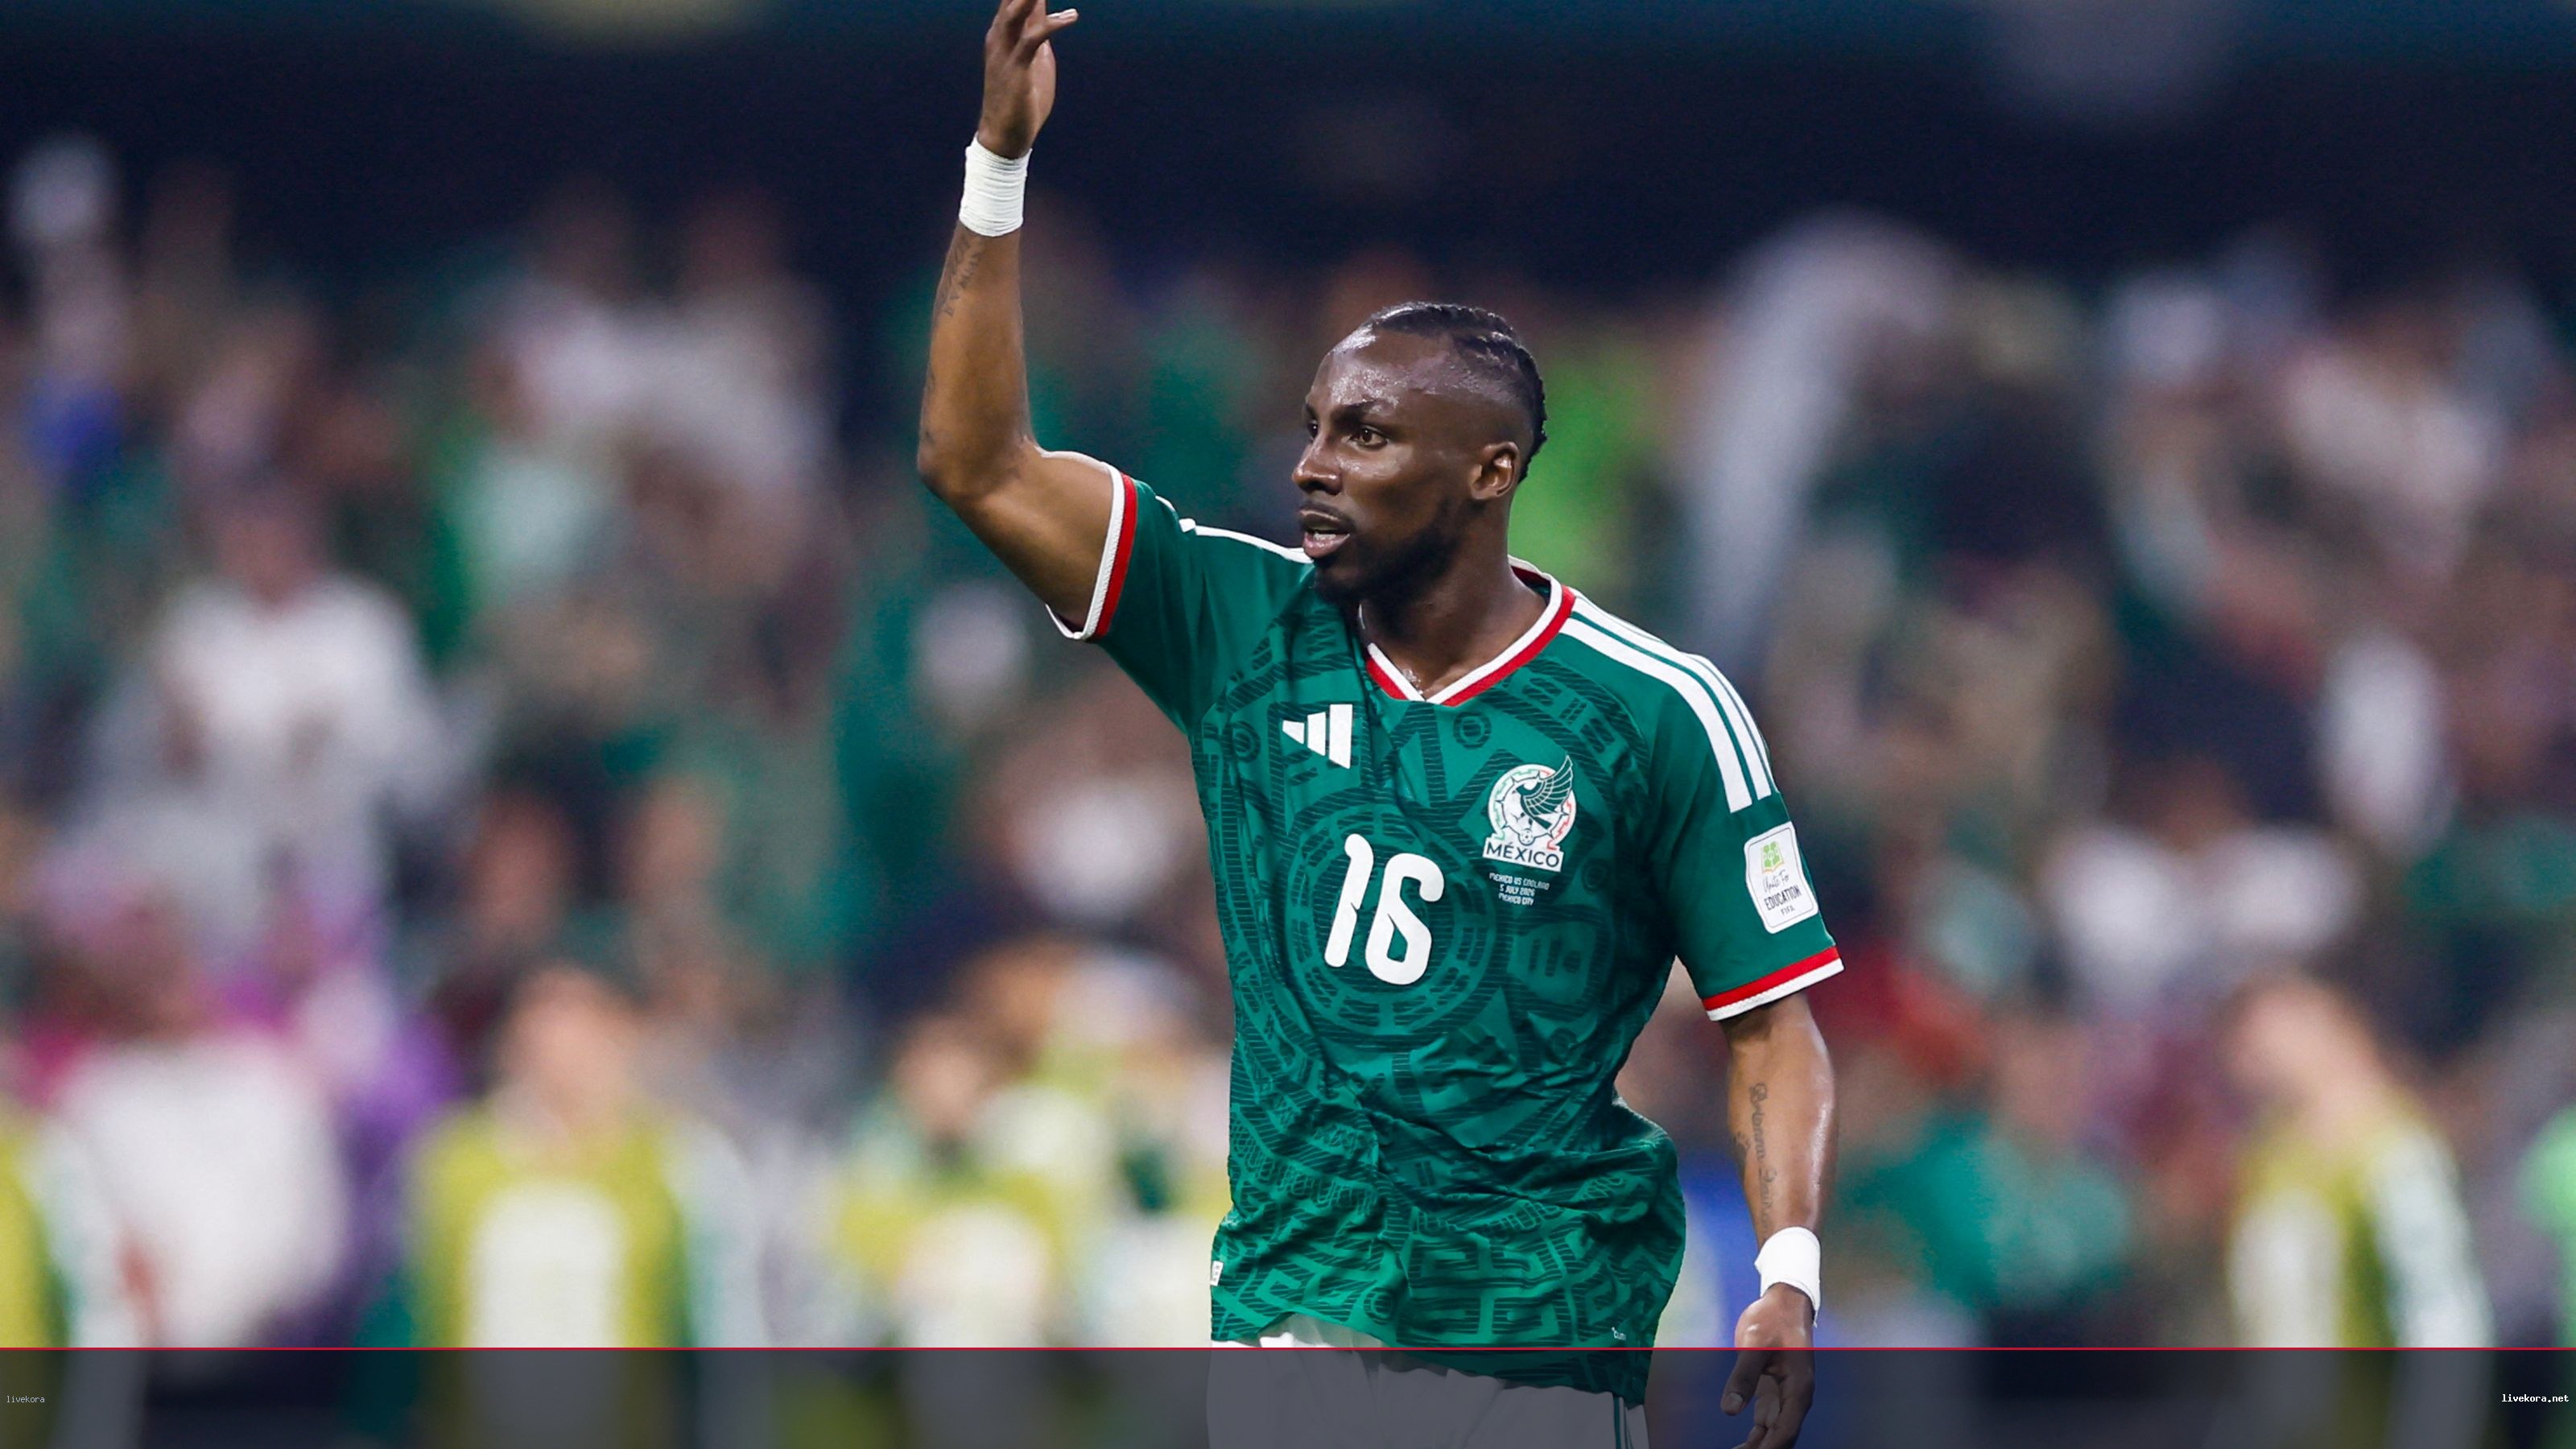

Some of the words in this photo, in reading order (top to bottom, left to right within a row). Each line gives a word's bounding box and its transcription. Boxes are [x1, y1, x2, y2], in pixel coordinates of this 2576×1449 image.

[1486, 841, 1560, 868] MÉXICO
[1499, 884, 1505, 892] 5
[1505, 886, 1519, 894] JULY
[1764, 885, 1802, 910] EDUCATION
[1324, 833, 1444, 985] 16
[1498, 893, 1521, 905] MEXICO
[1521, 897, 1534, 906] CITY
[1781, 904, 1796, 916] FIFA
